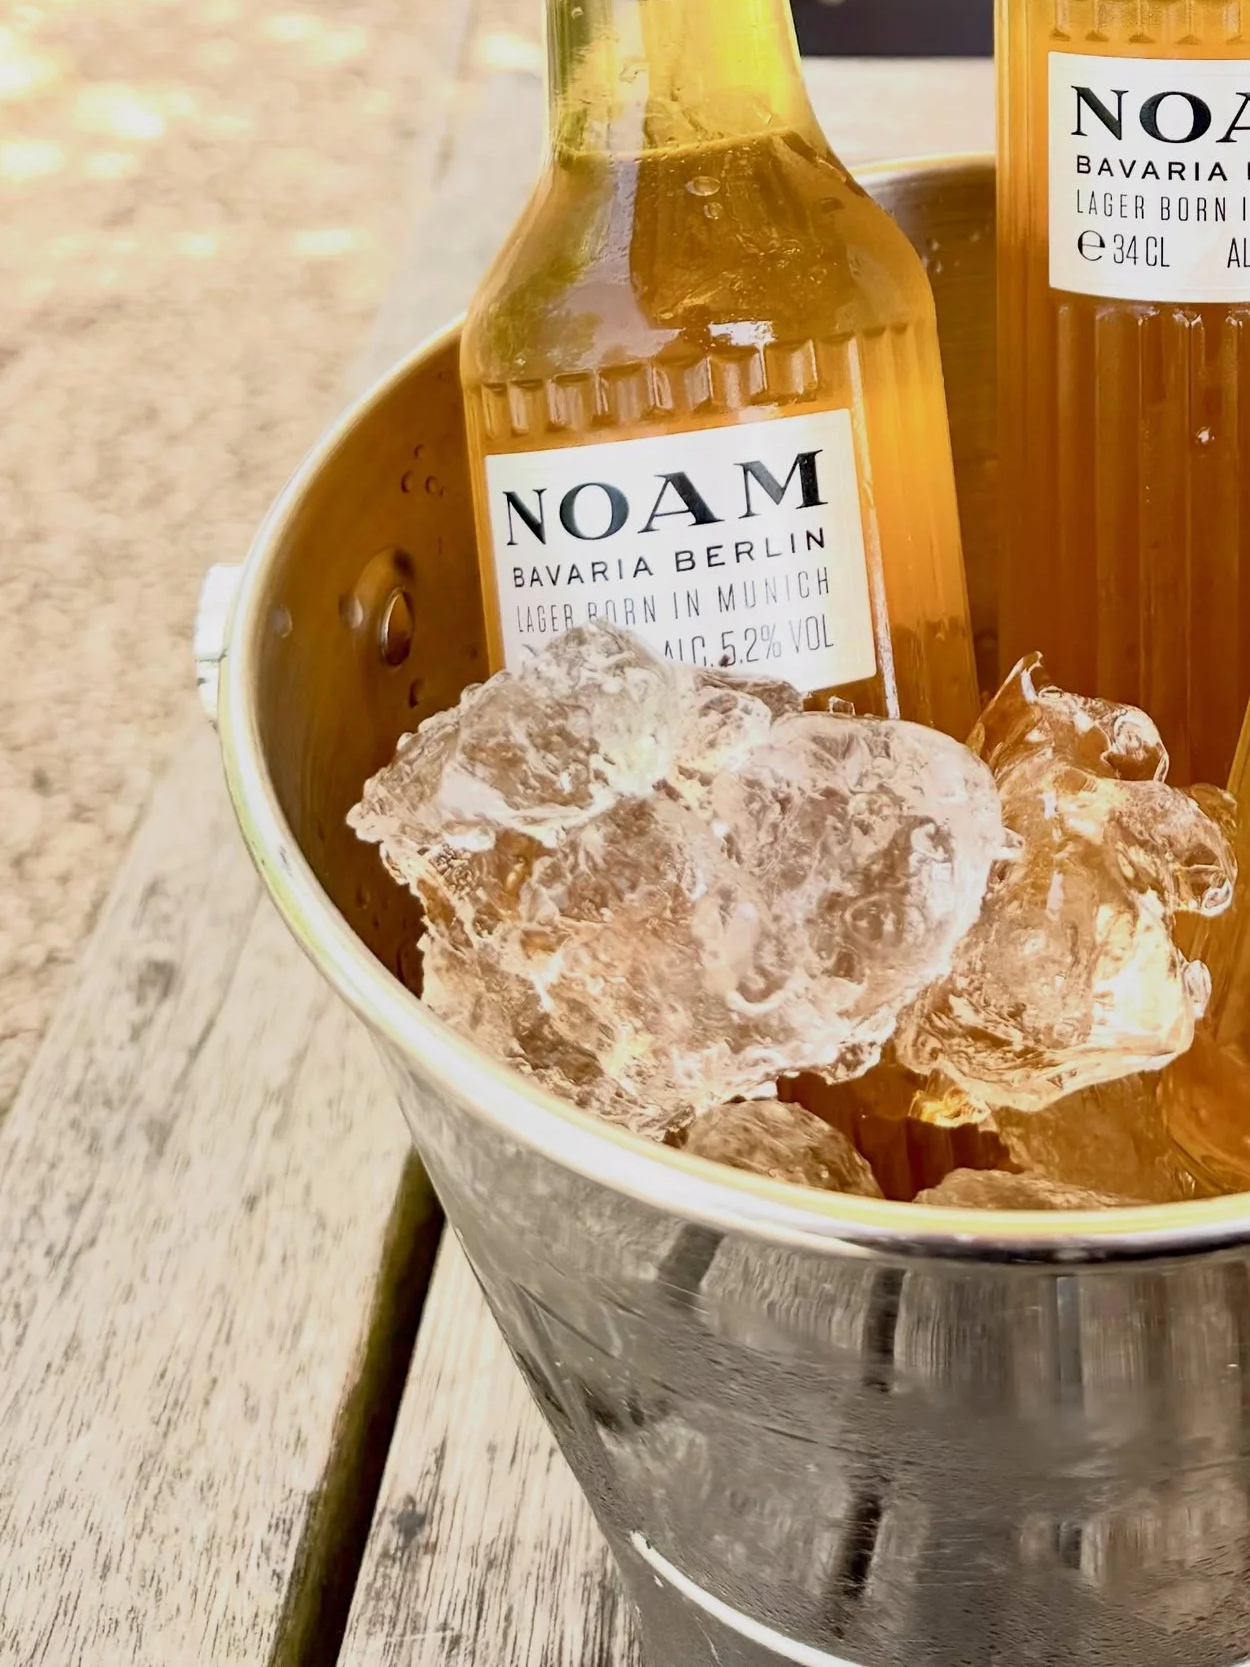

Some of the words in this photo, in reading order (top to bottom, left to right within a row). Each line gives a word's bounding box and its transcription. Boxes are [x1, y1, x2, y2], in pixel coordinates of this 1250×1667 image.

[1076, 154, 1228, 181] BAVARIA
[1076, 189, 1145, 220] LAGER
[1160, 196, 1227, 222] BORN
[502, 449, 829, 546] NOAM
[513, 556, 654, 588] BAVARIA
[674, 527, 826, 572] BERLIN
[516, 604, 574, 633] LAGER
[673, 589, 700, 620] IN
[717, 566, 830, 613] MUNICH
[788, 613, 835, 653] VOL
